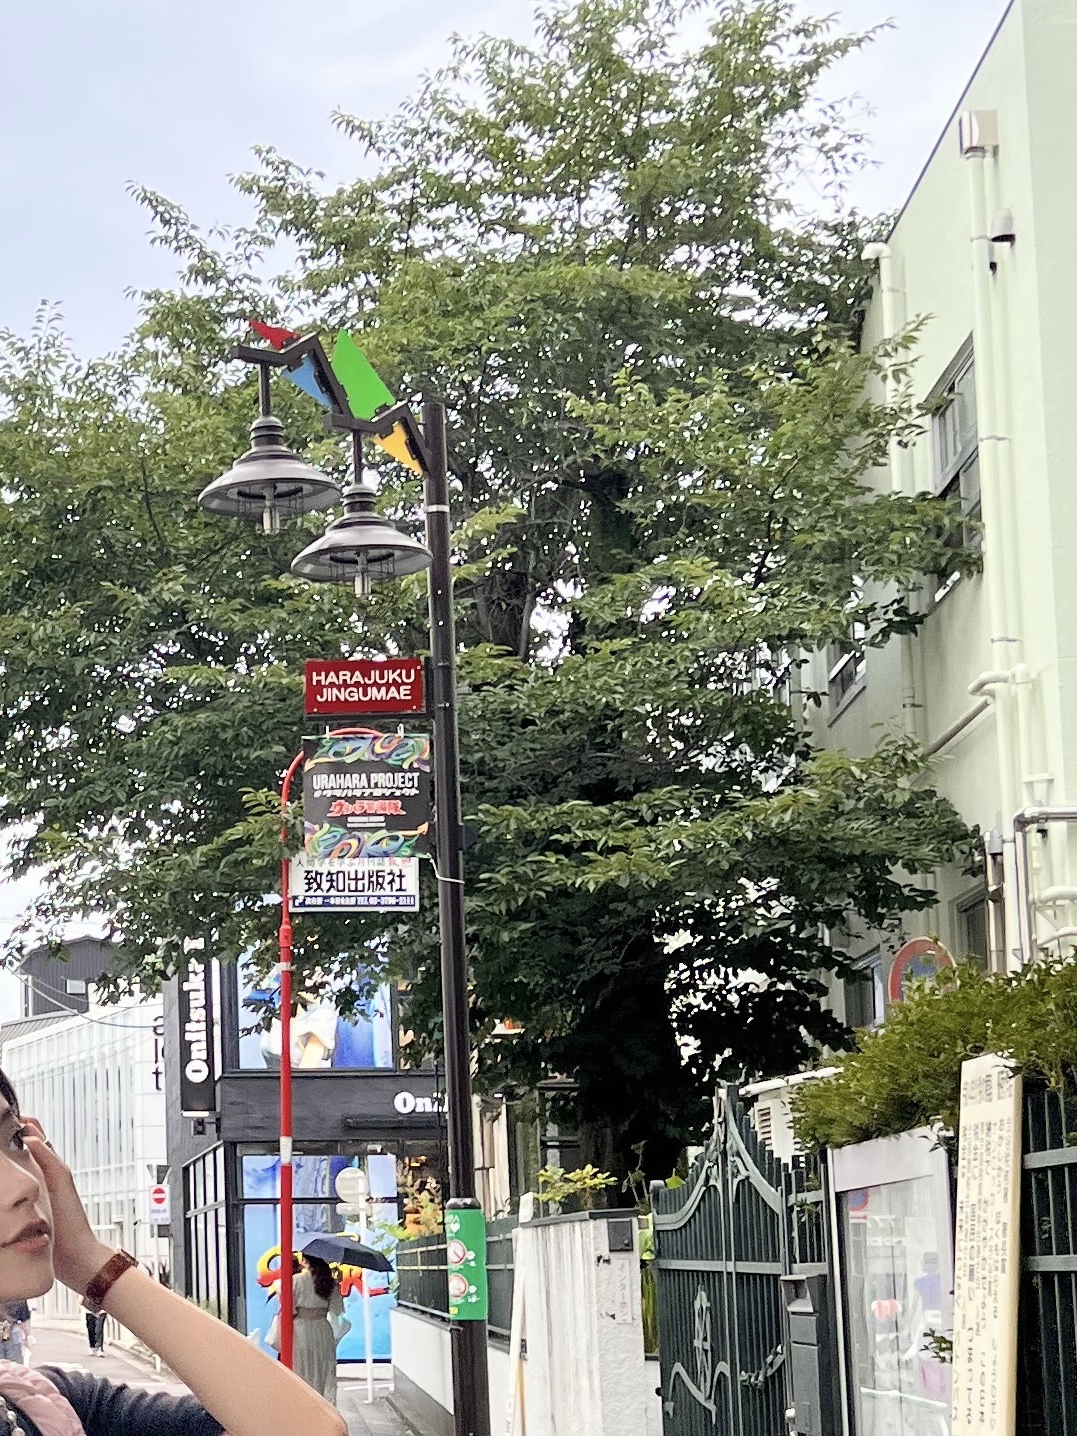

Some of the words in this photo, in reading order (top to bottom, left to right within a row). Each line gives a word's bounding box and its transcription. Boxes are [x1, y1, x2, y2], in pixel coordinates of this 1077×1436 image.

[312, 669, 415, 686] HARAJUKU
[316, 686, 412, 702] JINGUMAE
[312, 773, 368, 790] URAHARA
[370, 772, 420, 789] PROJECT
[303, 869, 407, 894] 致知出版社
